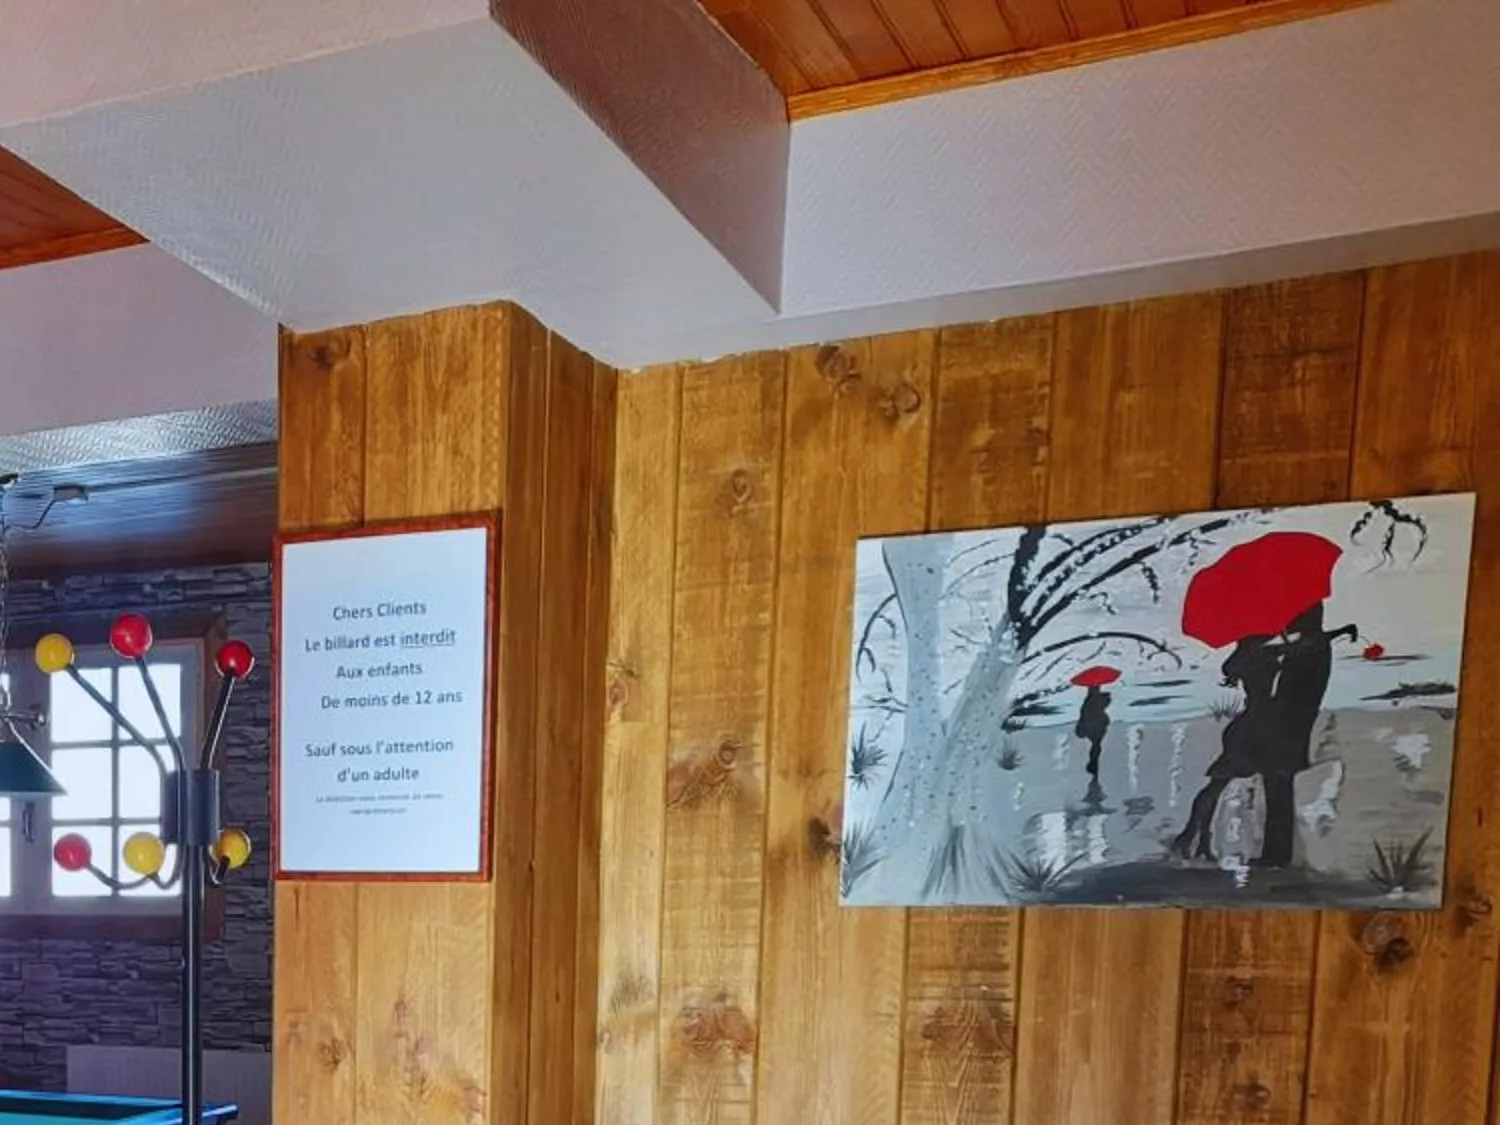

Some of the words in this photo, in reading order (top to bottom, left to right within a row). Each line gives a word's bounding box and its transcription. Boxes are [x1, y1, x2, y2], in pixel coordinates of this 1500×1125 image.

[332, 606, 373, 620] Chers
[376, 602, 427, 617] Clients
[304, 638, 322, 654] Le
[323, 633, 371, 652] billard
[372, 632, 397, 648] est
[401, 628, 456, 649] interdit
[335, 664, 364, 681] Aux
[366, 661, 424, 679] enfants
[320, 695, 341, 710] De
[344, 694, 388, 708] moins
[390, 690, 411, 707] de
[414, 689, 434, 706] 12
[435, 691, 463, 705] ans
[304, 741, 338, 758] Sauf
[339, 743, 373, 757] sous
[372, 765, 420, 782] adulte
